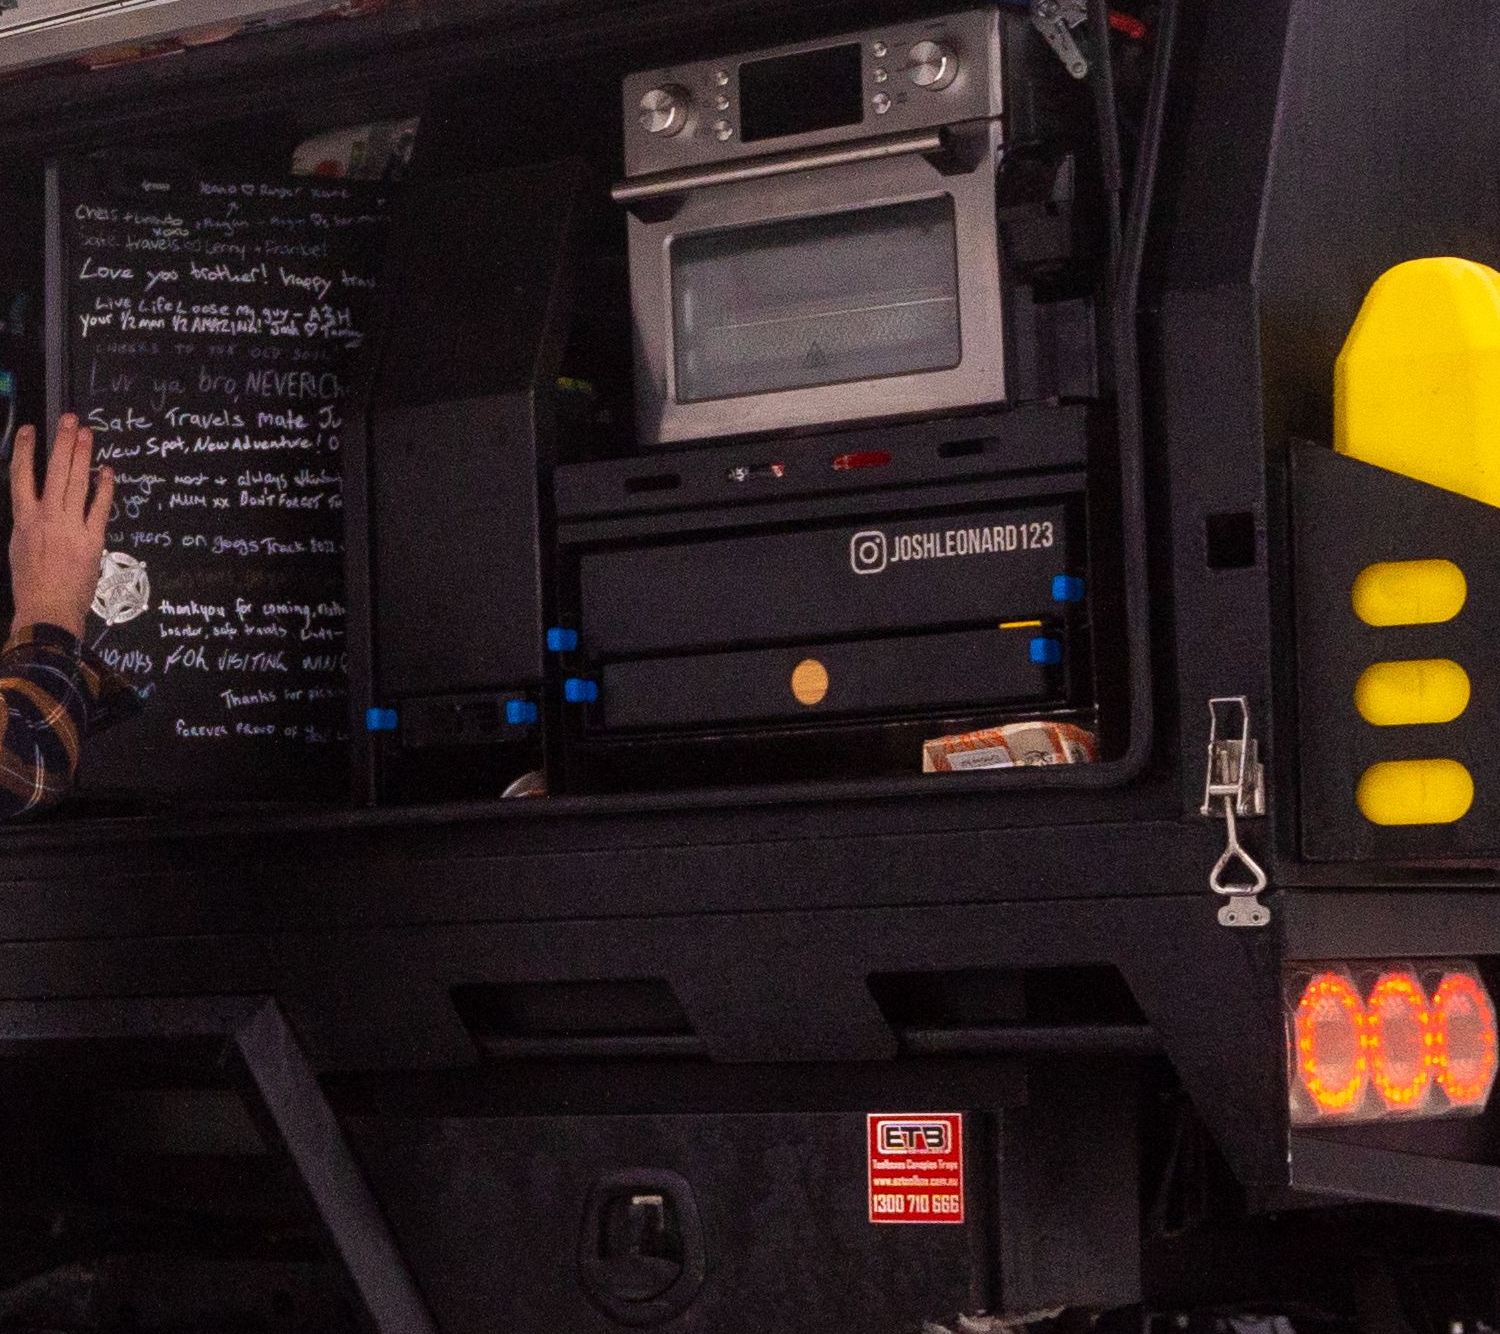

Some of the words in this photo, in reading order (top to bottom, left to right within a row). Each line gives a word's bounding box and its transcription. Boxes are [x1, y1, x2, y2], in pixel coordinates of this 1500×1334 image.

[79, 257, 134, 279] Love
[146, 269, 179, 292] you
[80, 313, 112, 338] your
[165, 407, 245, 429] Travels
[96, 441, 141, 462] New
[193, 436, 230, 454] New
[890, 521, 1054, 562] JOSHLEONARD123
[235, 598, 253, 623] for
[220, 687, 277, 710] Thanks
[885, 1126, 945, 1148] ETB
[873, 1194, 904, 1214] 1300
[906, 1194, 930, 1214] 710
[932, 1194, 960, 1214] 666
